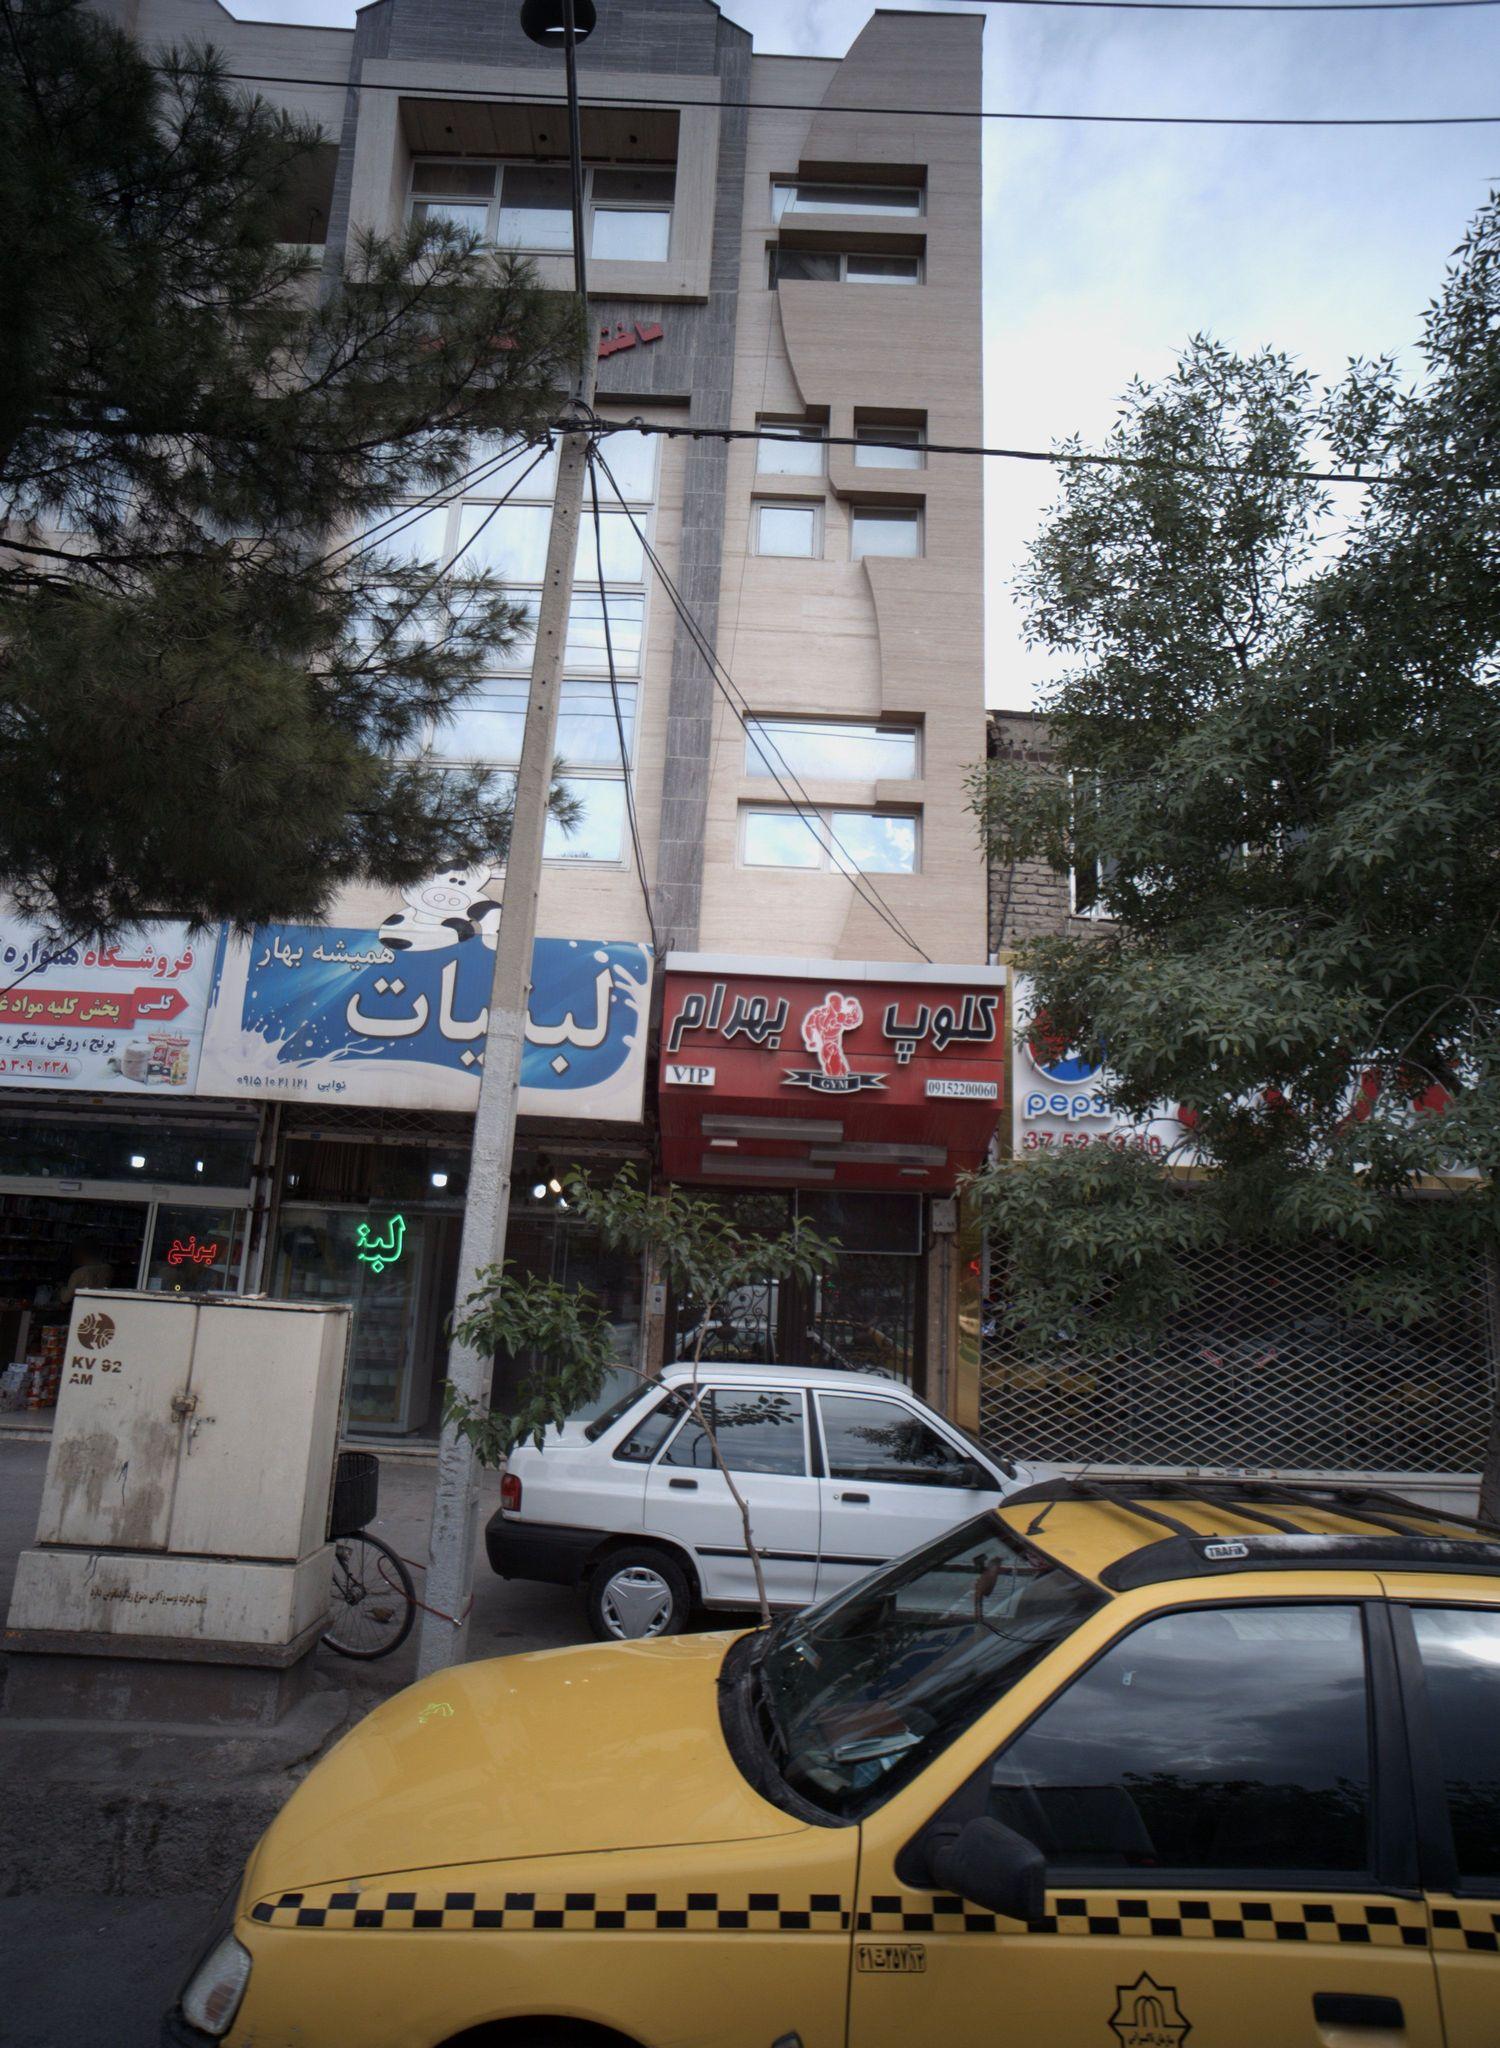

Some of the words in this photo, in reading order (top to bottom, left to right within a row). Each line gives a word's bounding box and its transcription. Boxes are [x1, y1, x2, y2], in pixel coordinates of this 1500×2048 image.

[4, 940, 79, 973] همواره
[84, 946, 194, 977] فروشگاه
[257, 935, 304, 968] بهار
[312, 939, 396, 969] همیشه
[11, 995, 44, 1019] مواد
[47, 997, 79, 1018] کلیه
[79, 999, 121, 1023] پخش
[137, 994, 175, 1013] کلی
[667, 983, 790, 1052] بهرام
[883, 995, 999, 1064] کلوپ
[673, 1067, 711, 1083] VIP
[821, 1079, 849, 1090] GYM
[928, 1081, 997, 1097] 09152200060
[168, 1235, 218, 1265] برنج
[72, 1356, 96, 1370] KV
[101, 1359, 122, 1373] 92
[69, 1373, 93, 1386] AM
